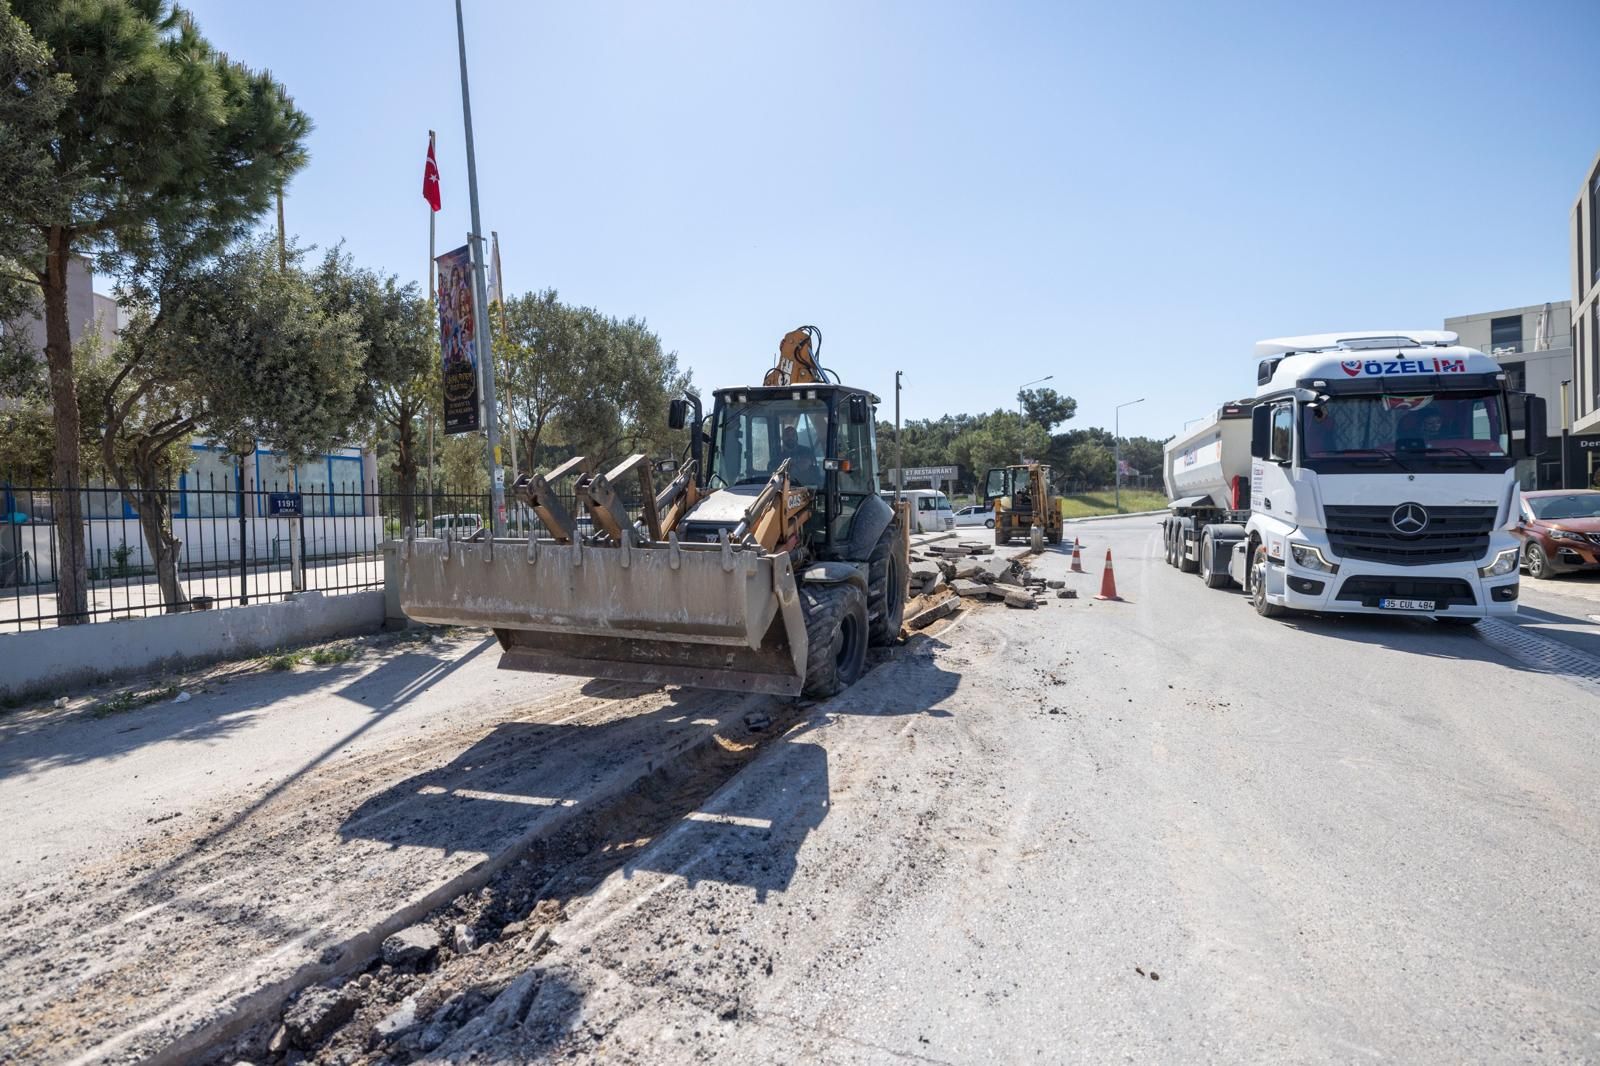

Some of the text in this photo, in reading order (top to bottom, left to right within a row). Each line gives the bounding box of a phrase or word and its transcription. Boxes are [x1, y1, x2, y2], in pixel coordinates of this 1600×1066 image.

[1364, 358, 1465, 375] ÖZELİM
[1385, 600, 1396, 608] 35
[1400, 601, 1415, 609] CUL
